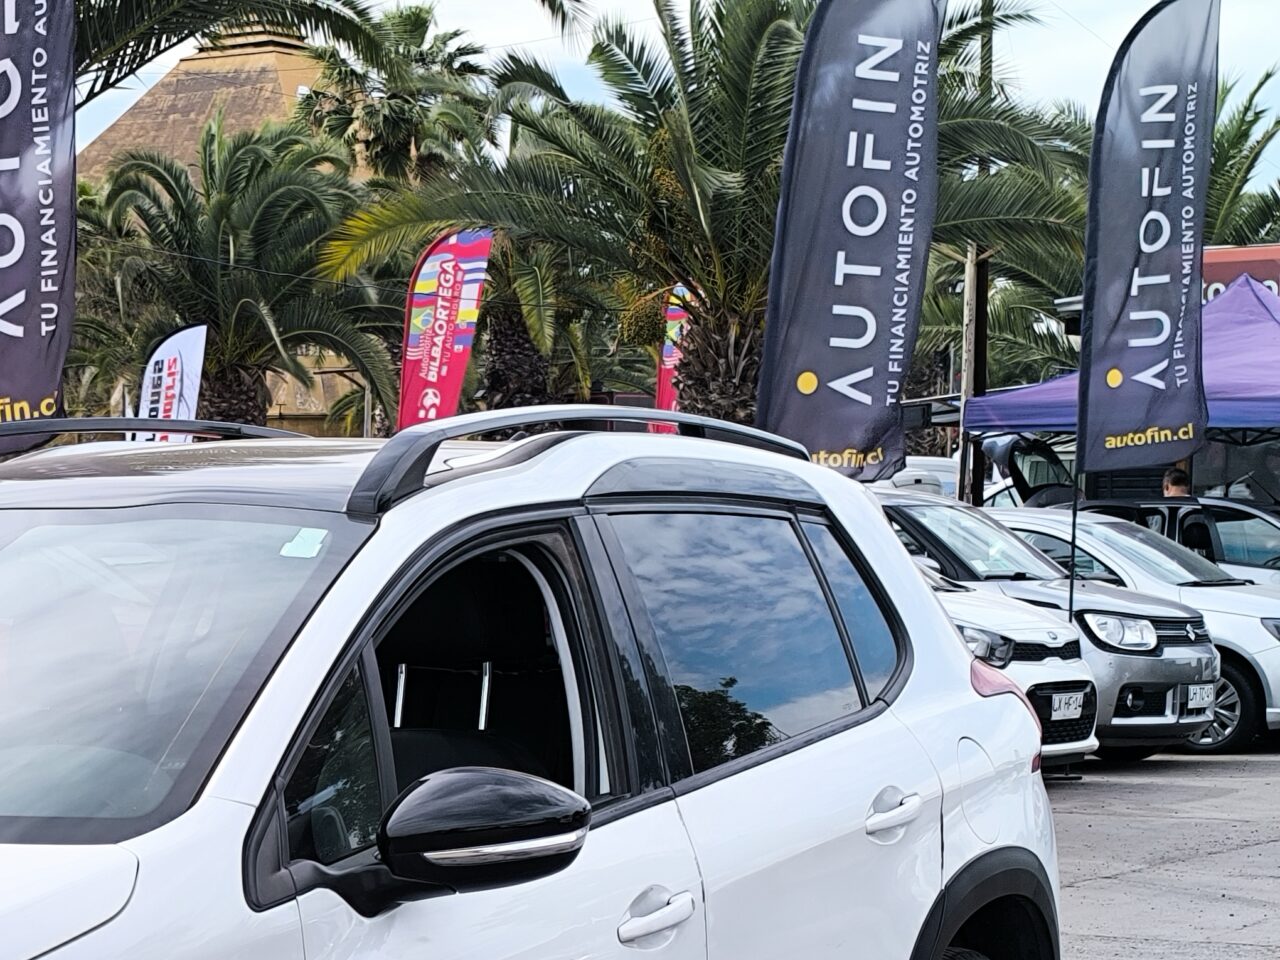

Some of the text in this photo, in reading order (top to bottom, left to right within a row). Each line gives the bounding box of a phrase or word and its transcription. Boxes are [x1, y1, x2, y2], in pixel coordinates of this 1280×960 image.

[31, 46, 59, 293] FINANCIAMIENTO
[1182, 82, 1198, 199] AUTOMOTRIZ
[826, 34, 903, 406] AUTOFIN
[886, 40, 931, 406] TU FINANCIAMIENTO AUTOMOTRIZ
[1128, 85, 1178, 390] AUTOFIN
[40, 303, 59, 337] TU
[427, 260, 457, 383] BILBAORTEGA
[442, 351, 451, 363] TU
[445, 323, 455, 349] AUTO
[1176, 365, 1189, 388] TU
[1104, 422, 1194, 449] autofin.cl
